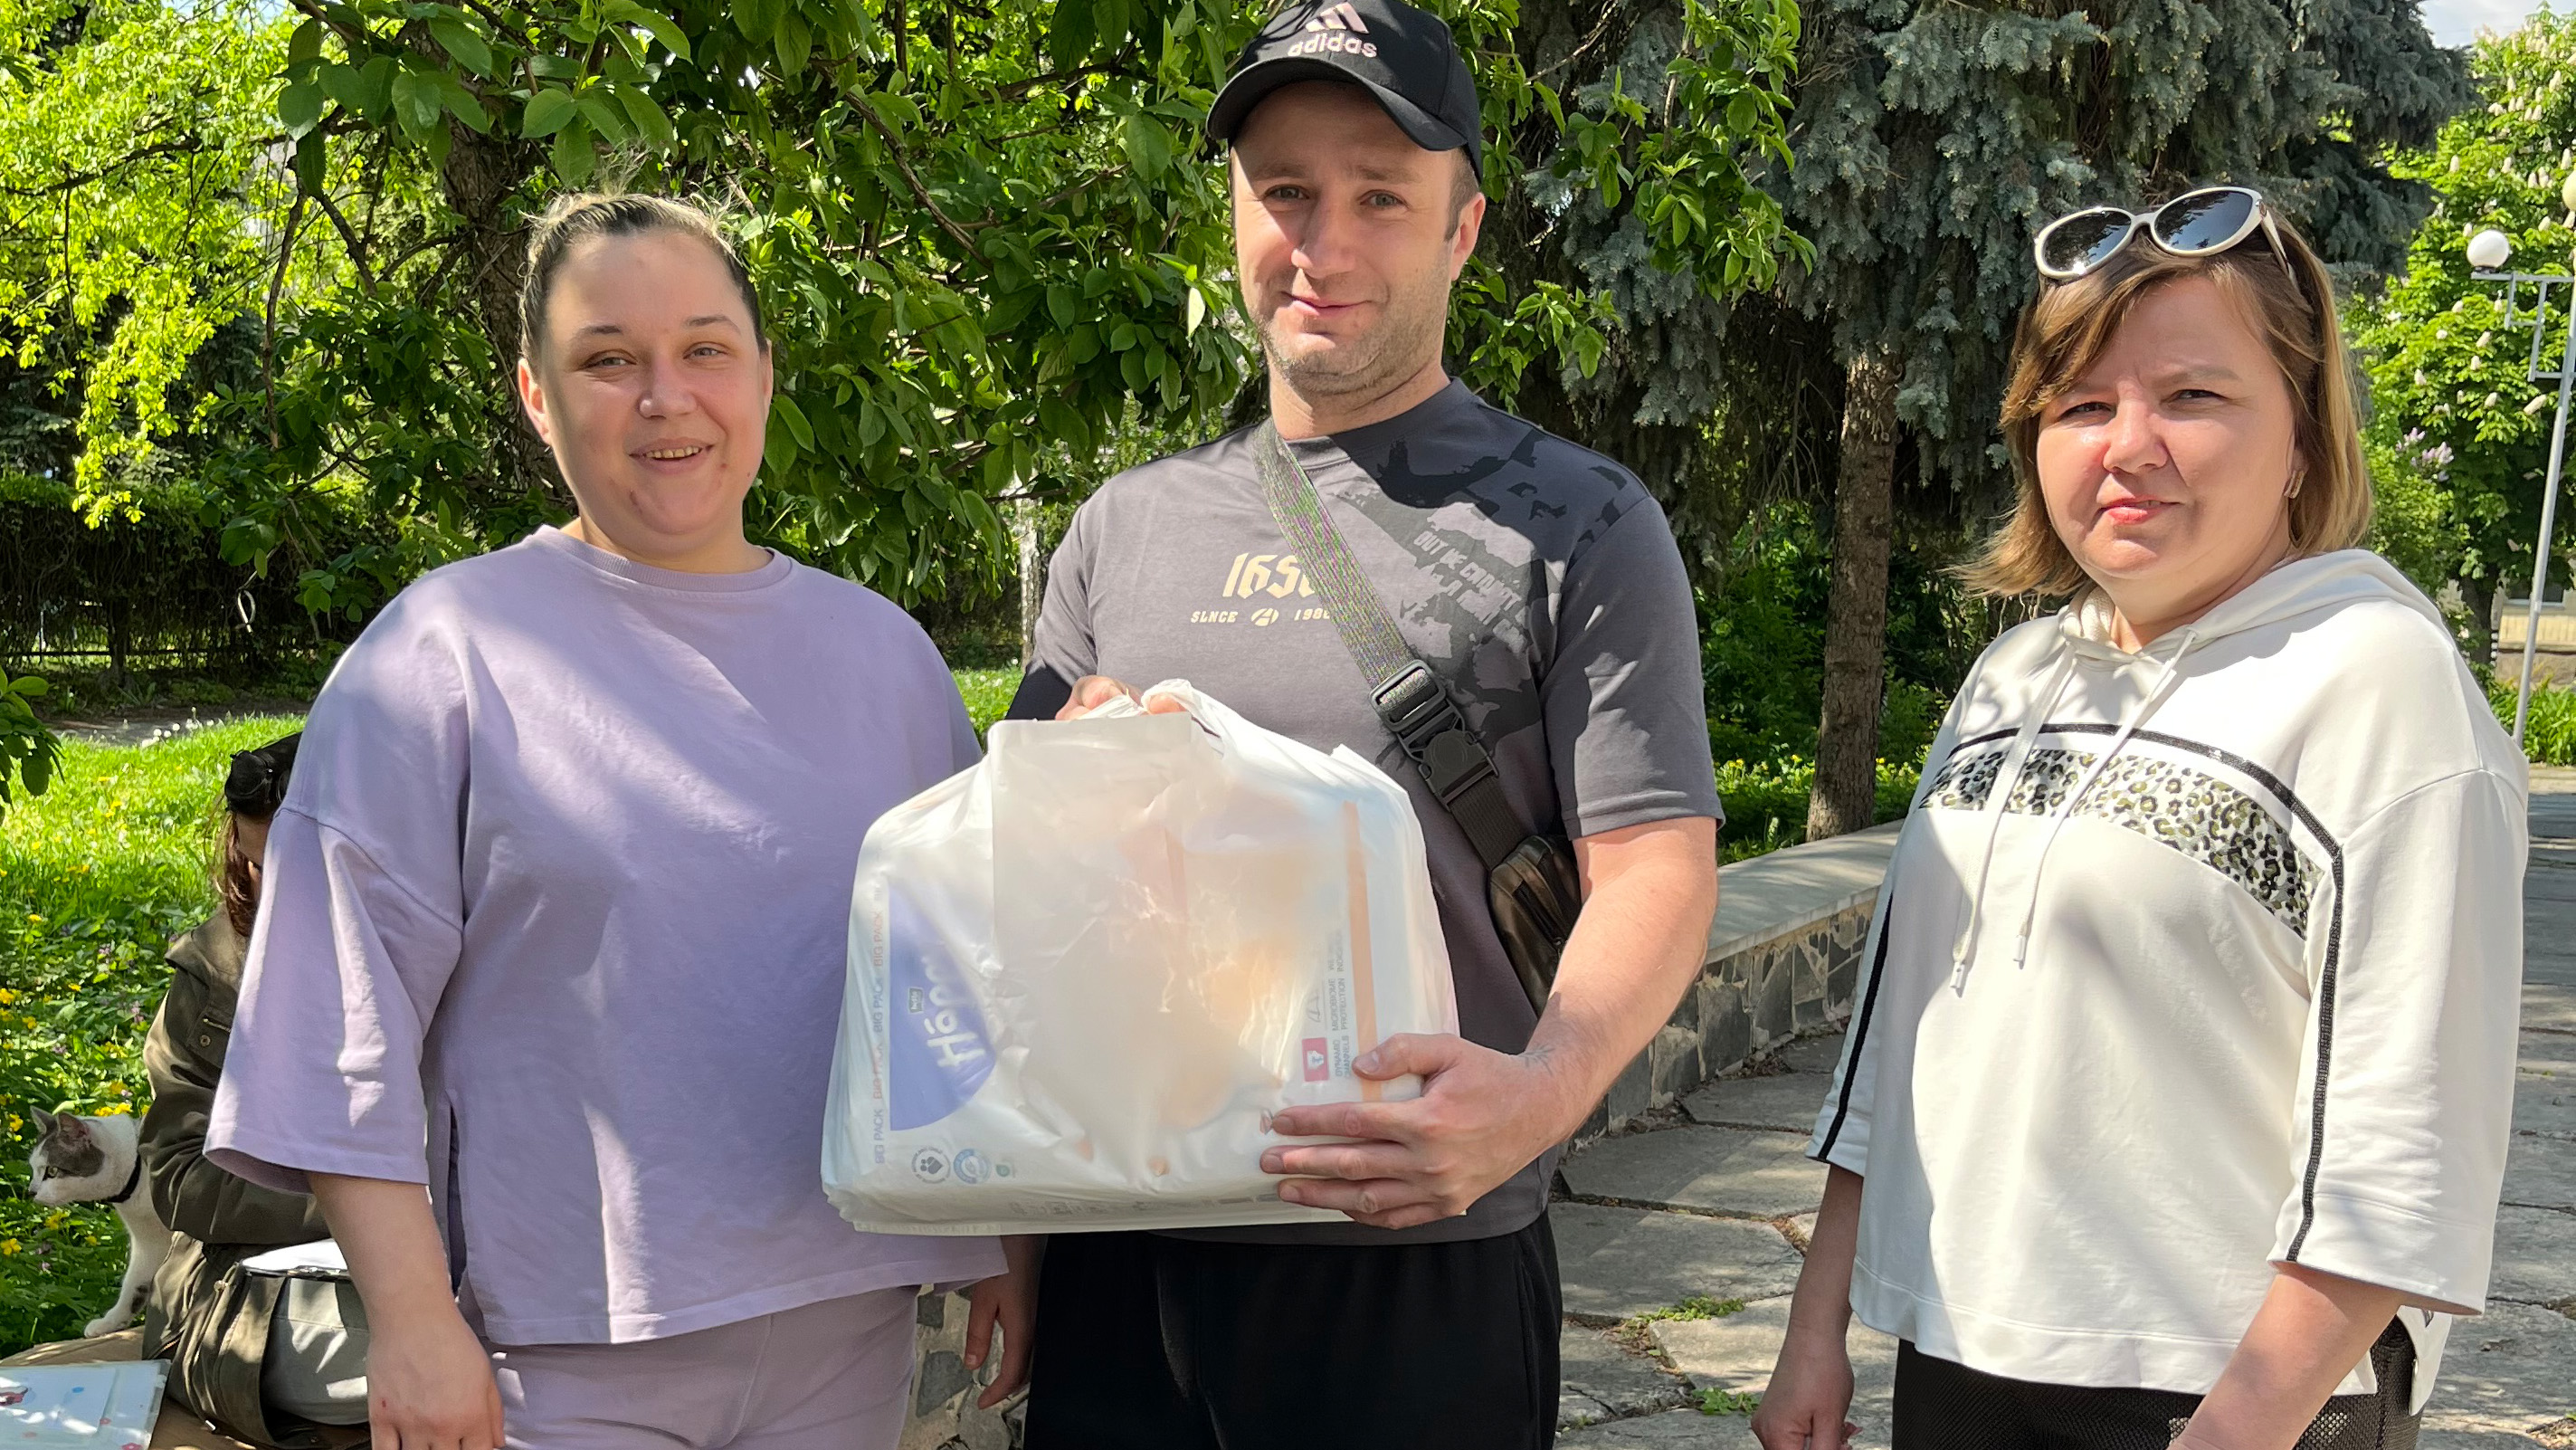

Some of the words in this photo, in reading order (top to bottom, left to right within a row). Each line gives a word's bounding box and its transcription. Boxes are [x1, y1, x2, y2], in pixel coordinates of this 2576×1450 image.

[1288, 33, 1378, 58] adidas
[872, 911, 884, 942] PACK
[872, 946, 883, 967] BIG
[1338, 978, 1348, 1030] PROTECTION
[872, 1011, 884, 1034] BIG
[873, 1108, 884, 1141] PACK
